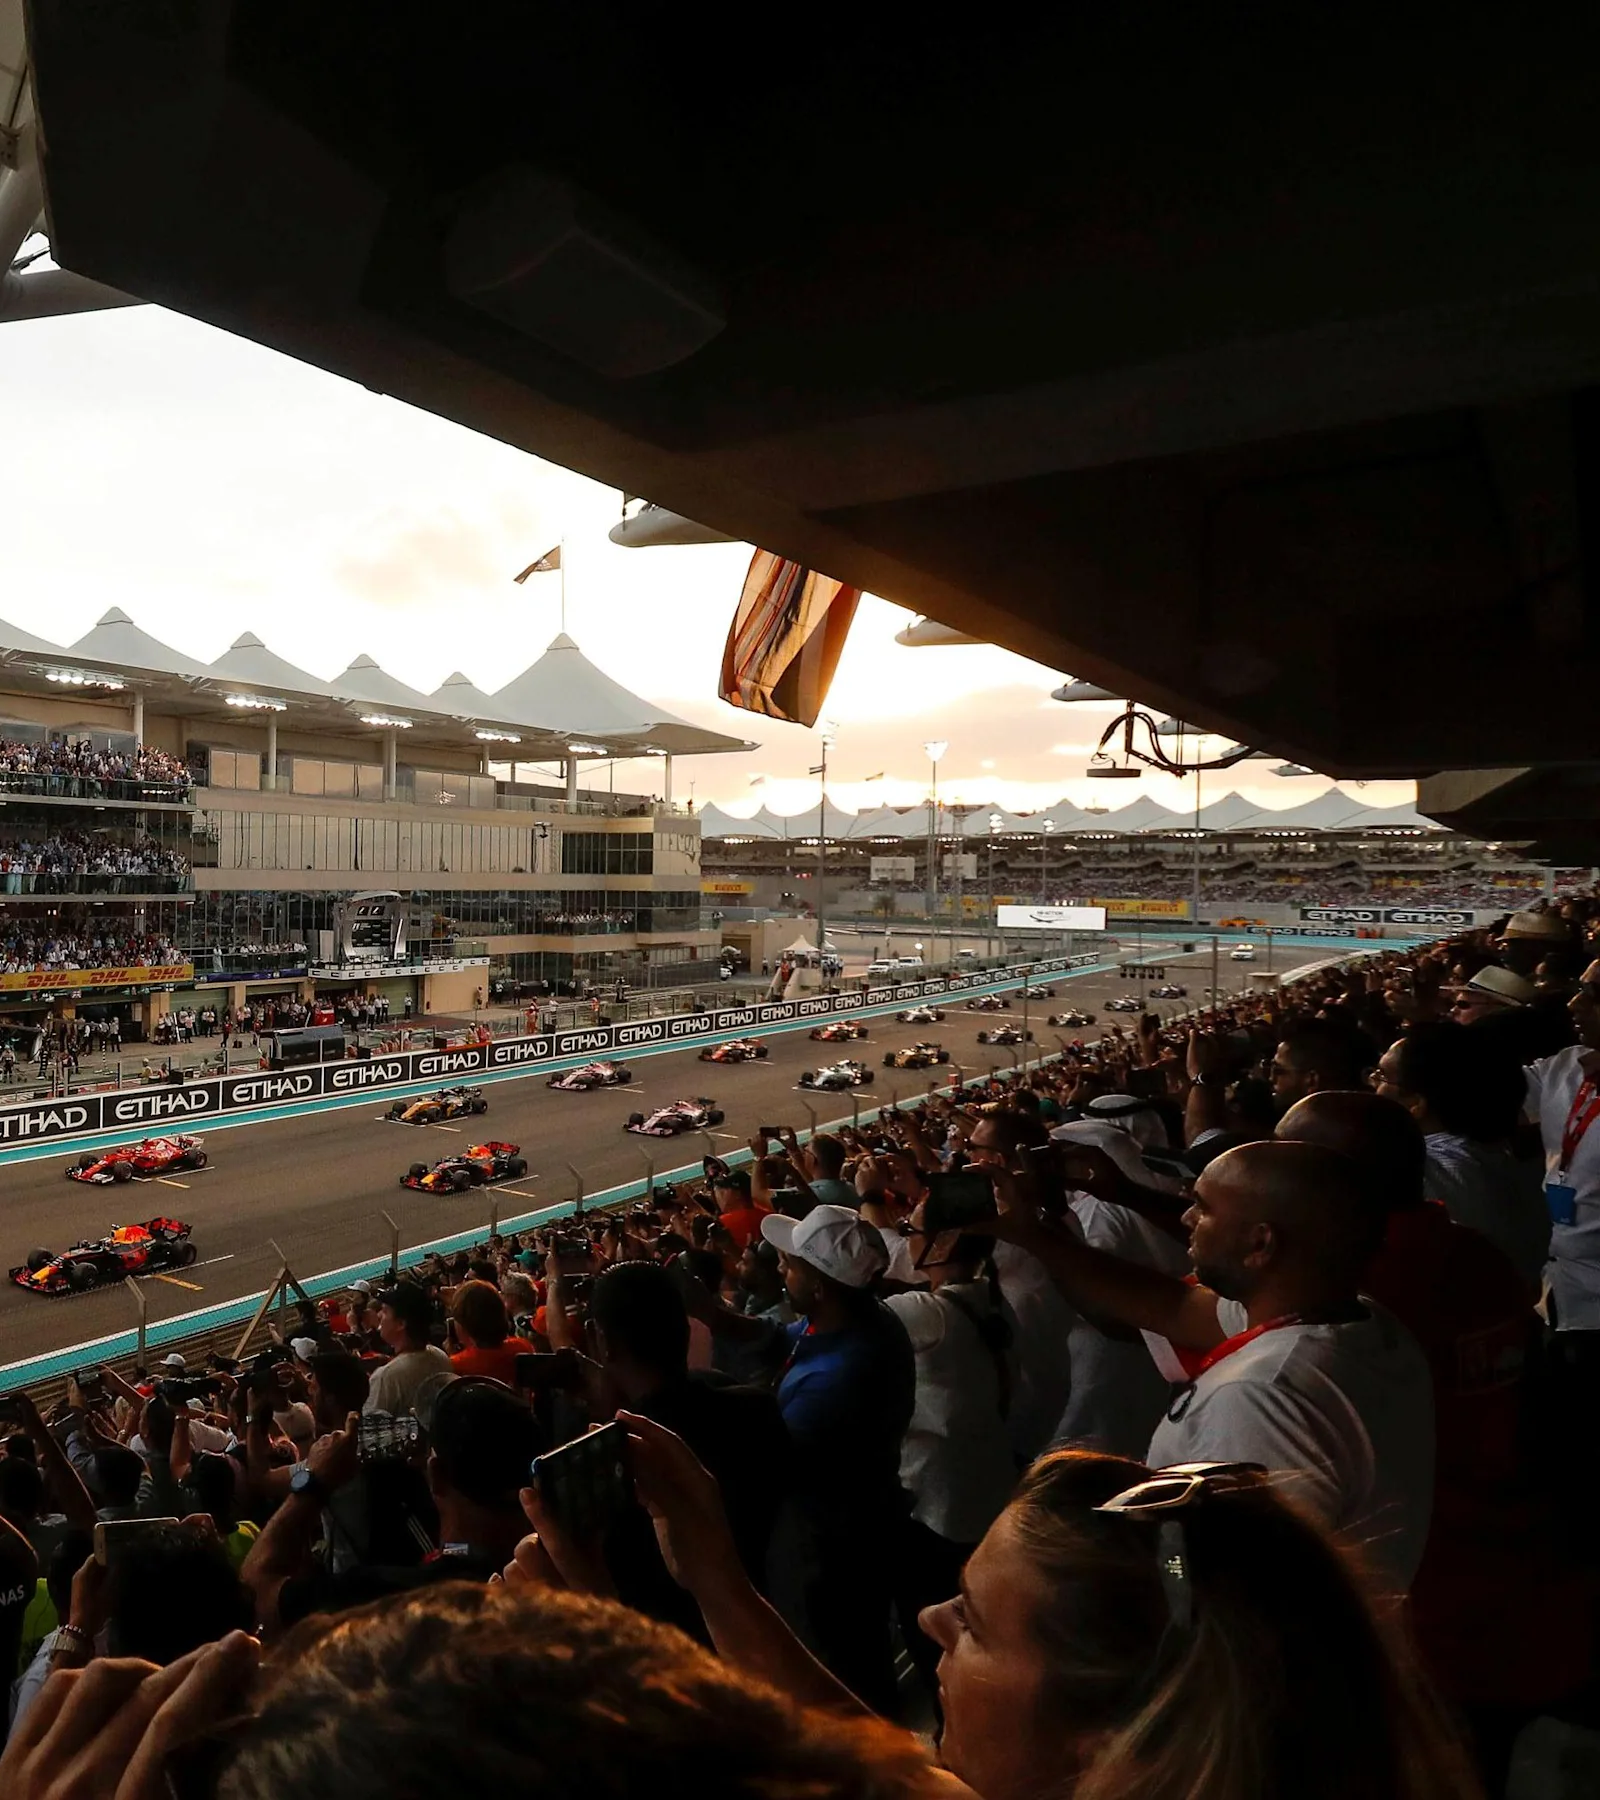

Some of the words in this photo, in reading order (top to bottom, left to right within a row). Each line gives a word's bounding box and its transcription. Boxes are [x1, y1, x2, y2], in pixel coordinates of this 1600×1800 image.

[1307, 911, 1373, 921] ETIHAD
[1391, 911, 1464, 923] ETIHAD
[88, 971, 130, 984] DHL
[149, 967, 186, 979] DHL
[27, 974, 70, 988] DHL
[867, 990, 892, 1003] ETIHAD
[897, 986, 919, 999] ETIHAD
[800, 999, 829, 1014] ETIHAD
[835, 995, 862, 1009] ETIHAD
[718, 1010, 753, 1027] ETIHAD
[761, 1005, 793, 1020] ETIHAD
[619, 1024, 662, 1043] ETIHAD
[672, 1017, 710, 1035] ETIHAD
[561, 1033, 608, 1051] ETIHAD
[495, 1041, 548, 1062] ETIHAD
[419, 1050, 480, 1074] ETIHAD
[332, 1062, 402, 1087] ETIHAD
[232, 1075, 312, 1103] ETIHAD
[115, 1089, 209, 1120] ETIHAD
